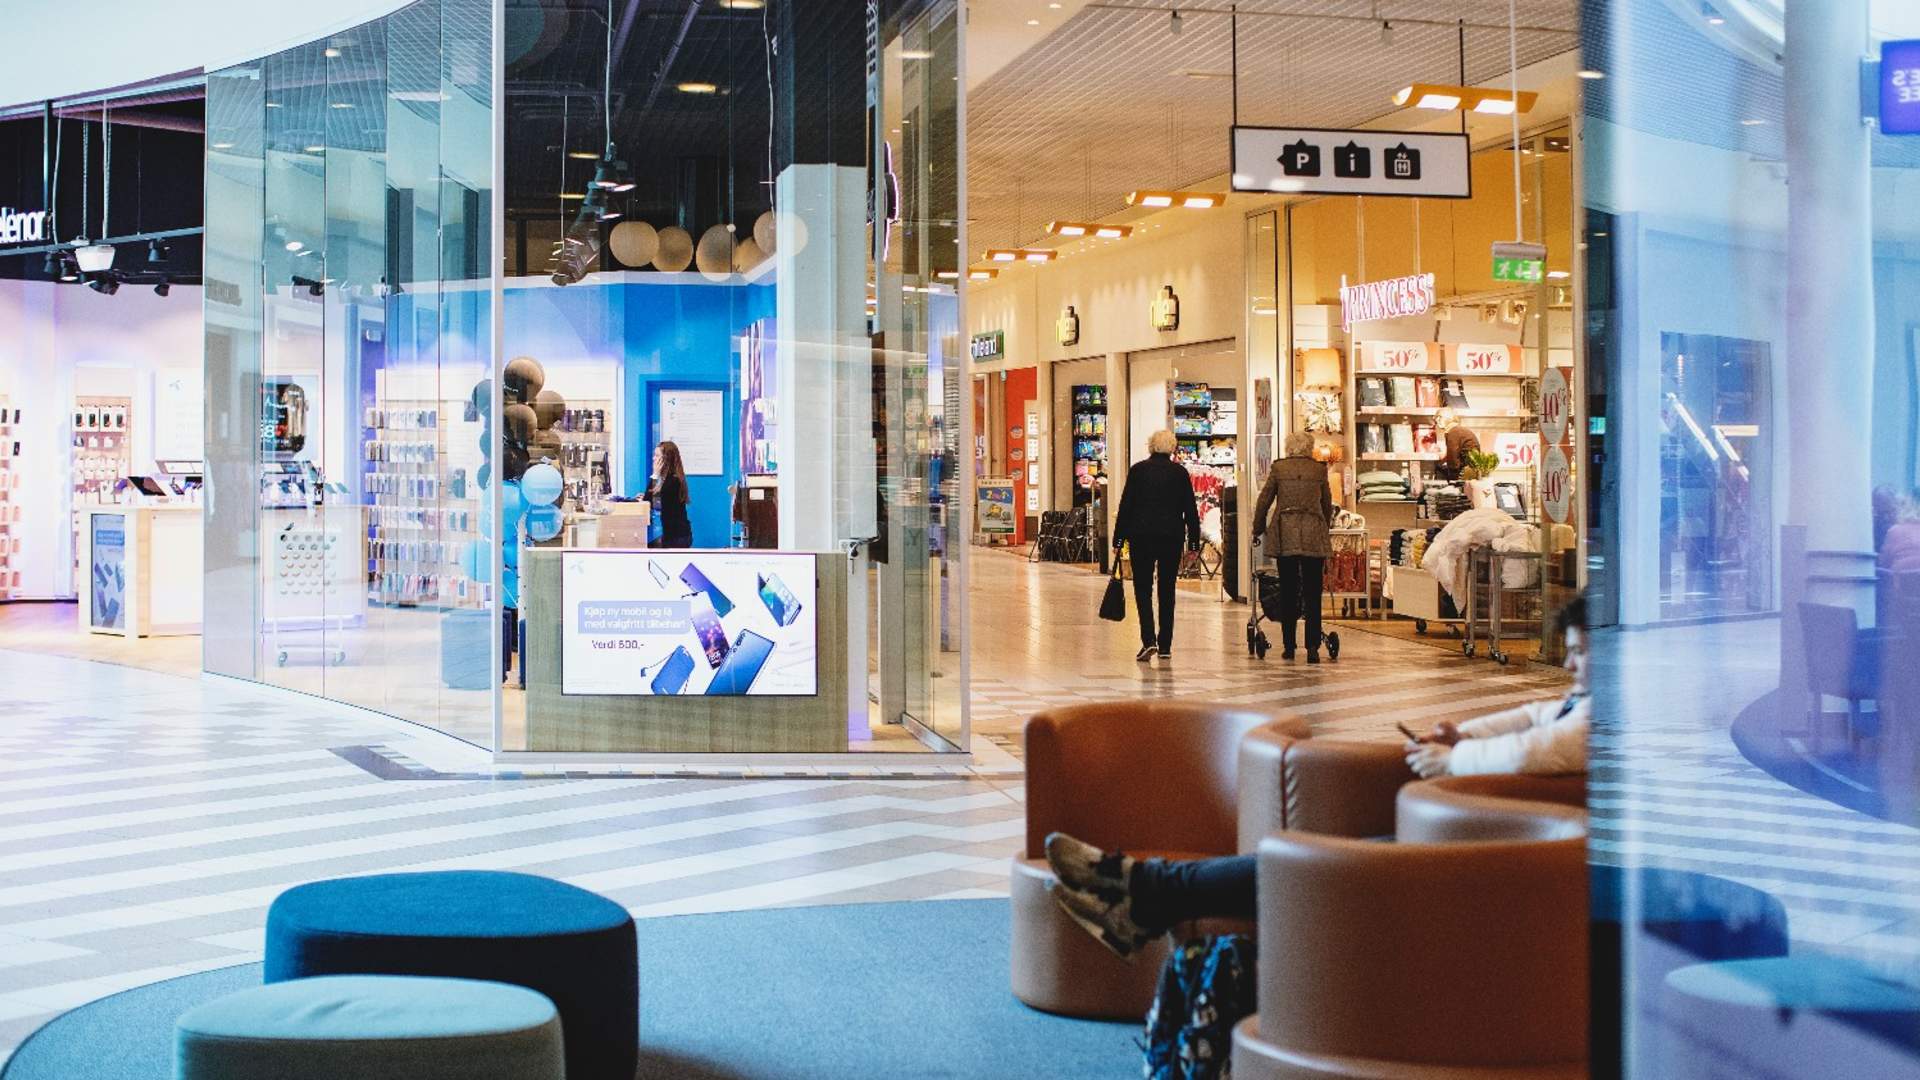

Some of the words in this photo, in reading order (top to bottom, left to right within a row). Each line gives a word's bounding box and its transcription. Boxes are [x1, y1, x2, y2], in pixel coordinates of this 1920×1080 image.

[1296, 152, 1310, 170] P
[1383, 349, 1421, 369] 50%
[1465, 351, 1503, 370] 50%
[591, 639, 616, 649] Verdi
